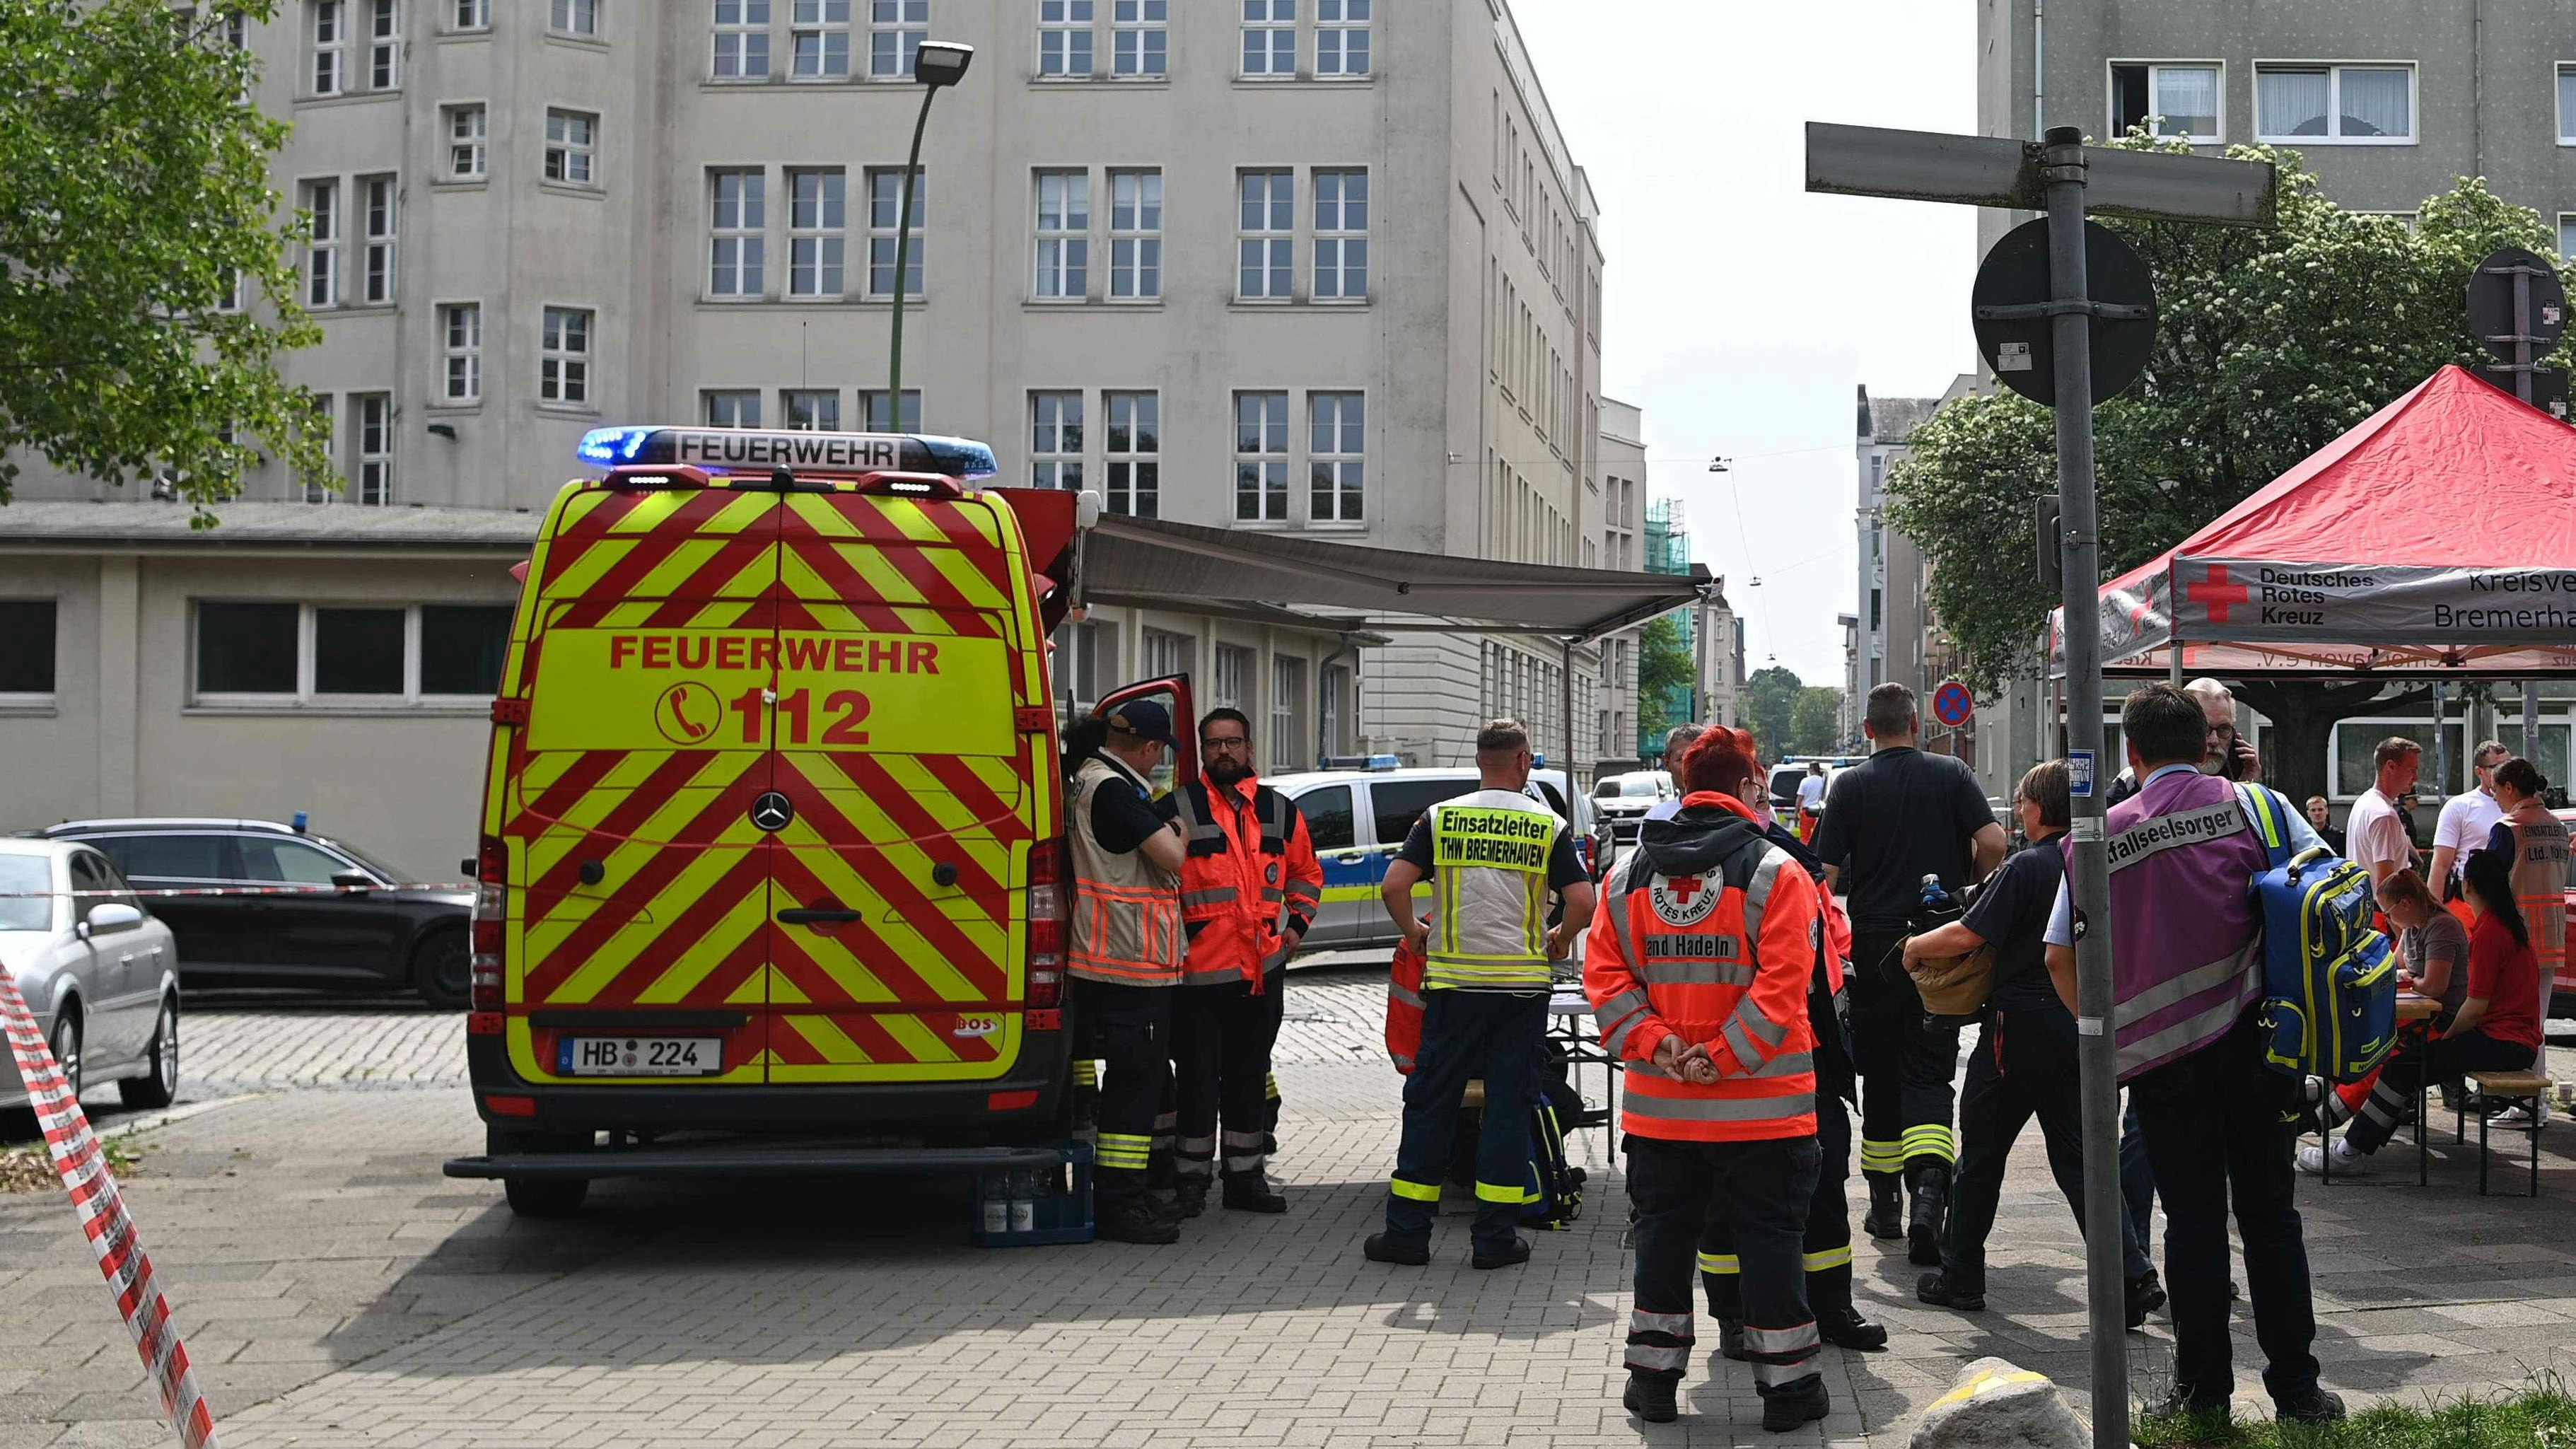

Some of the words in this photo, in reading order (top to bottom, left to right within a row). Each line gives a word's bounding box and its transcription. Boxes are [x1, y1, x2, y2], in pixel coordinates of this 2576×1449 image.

[681, 434, 894, 466] FEUERWEHR
[2260, 568, 2374, 588] Deutsches
[2261, 587, 2326, 604] Rotes
[2261, 606, 2324, 625] Kreuz
[610, 635, 940, 675] FEUERWEHR
[730, 688, 871, 745] 112
[1442, 810, 1548, 840] Einsatzleiter
[1440, 837, 1464, 860] THW
[1466, 838, 1546, 868] BREMERHAVEN
[1653, 887, 1679, 919] ROTES
[1682, 888, 1715, 920] KREUZ
[1645, 934, 1669, 956] and
[1676, 934, 1729, 956] Hadeln
[583, 1041, 618, 1066] HB
[648, 1041, 698, 1066] 224
